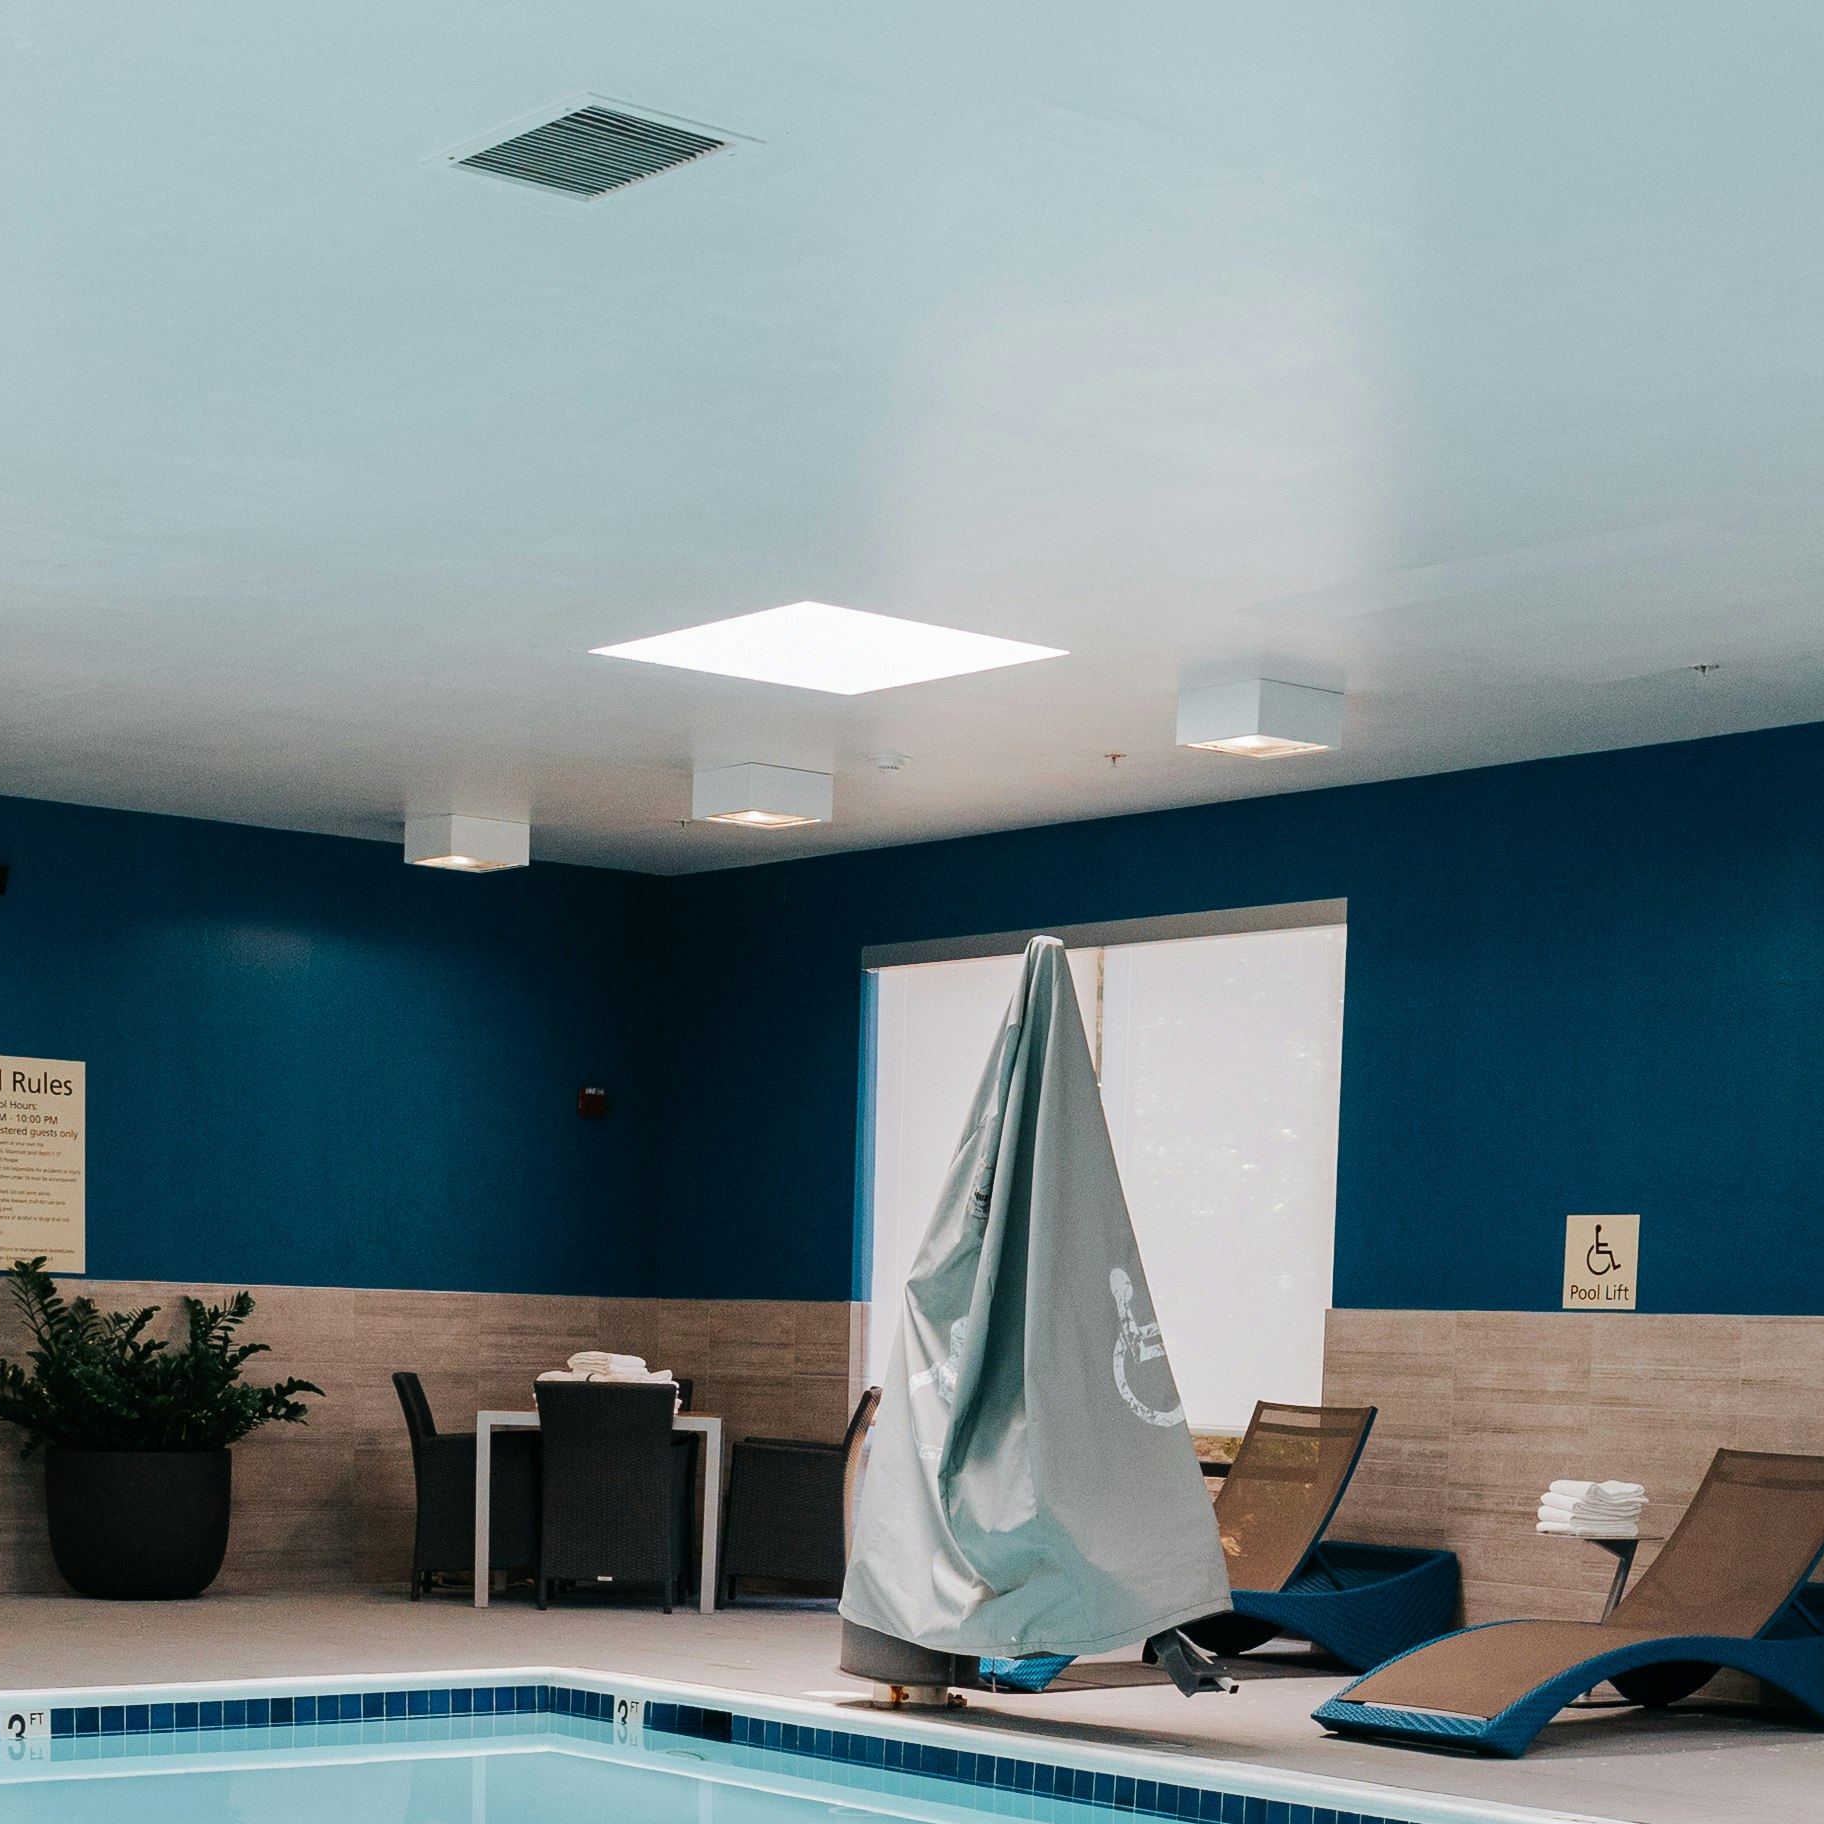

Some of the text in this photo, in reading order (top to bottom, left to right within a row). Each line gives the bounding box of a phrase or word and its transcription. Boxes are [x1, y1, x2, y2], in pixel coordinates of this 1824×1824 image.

[13, 1071, 73, 1096] Rules
[16, 1113, 41, 1123] 10:00
[44, 1115, 58, 1124] PM
[30, 1127, 57, 1138] guests
[60, 1129, 78, 1140] only
[1570, 1284, 1629, 1301] Pool Lift
[630, 1701, 639, 1714] FT
[30, 1712, 44, 1725] FT
